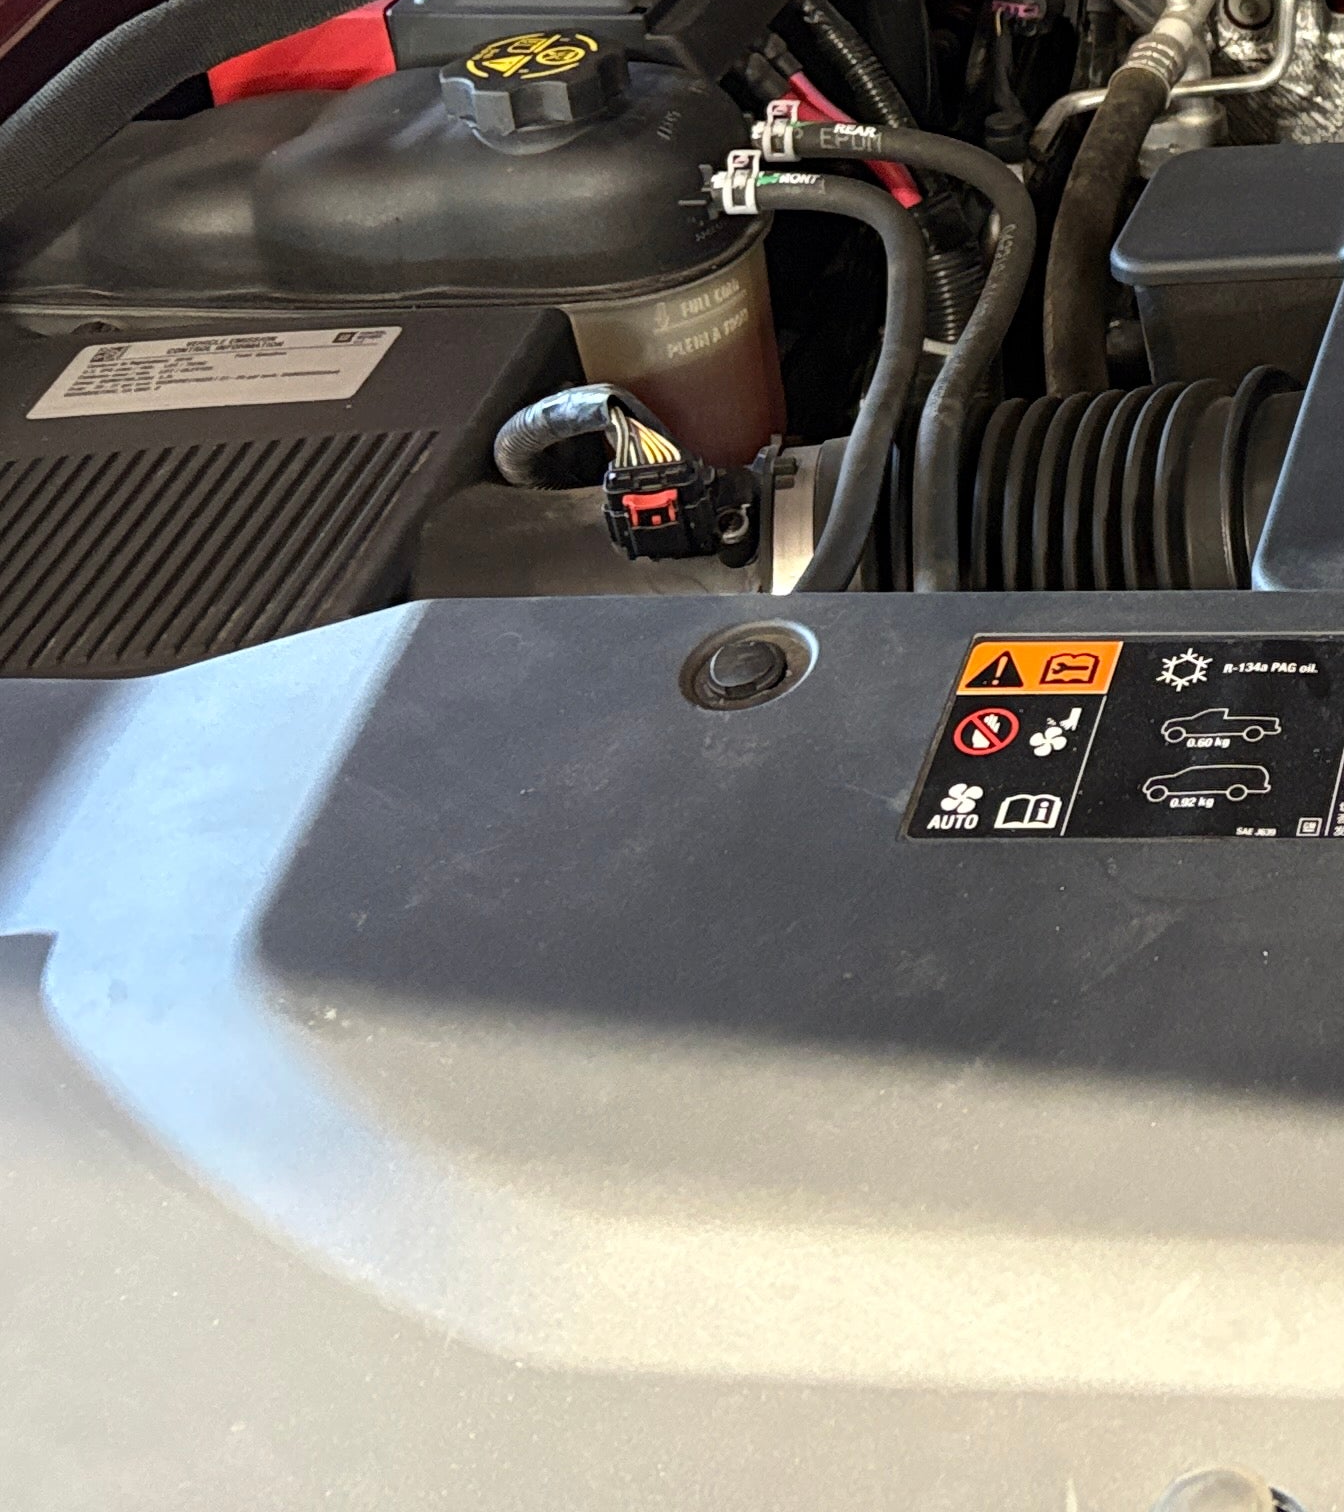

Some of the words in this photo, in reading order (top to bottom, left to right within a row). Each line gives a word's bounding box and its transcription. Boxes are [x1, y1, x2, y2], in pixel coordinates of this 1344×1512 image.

[833, 123, 877, 137] REAR
[1222, 663, 1268, 674] R-134a
[1270, 662, 1297, 673] PAG
[1186, 738, 1213, 748] 0.60
[1214, 737, 1230, 749] kg
[1169, 797, 1197, 808] 0.92
[1197, 797, 1215, 809] kg
[926, 814, 979, 829] AUTO
[1235, 827, 1254, 836] SAE
